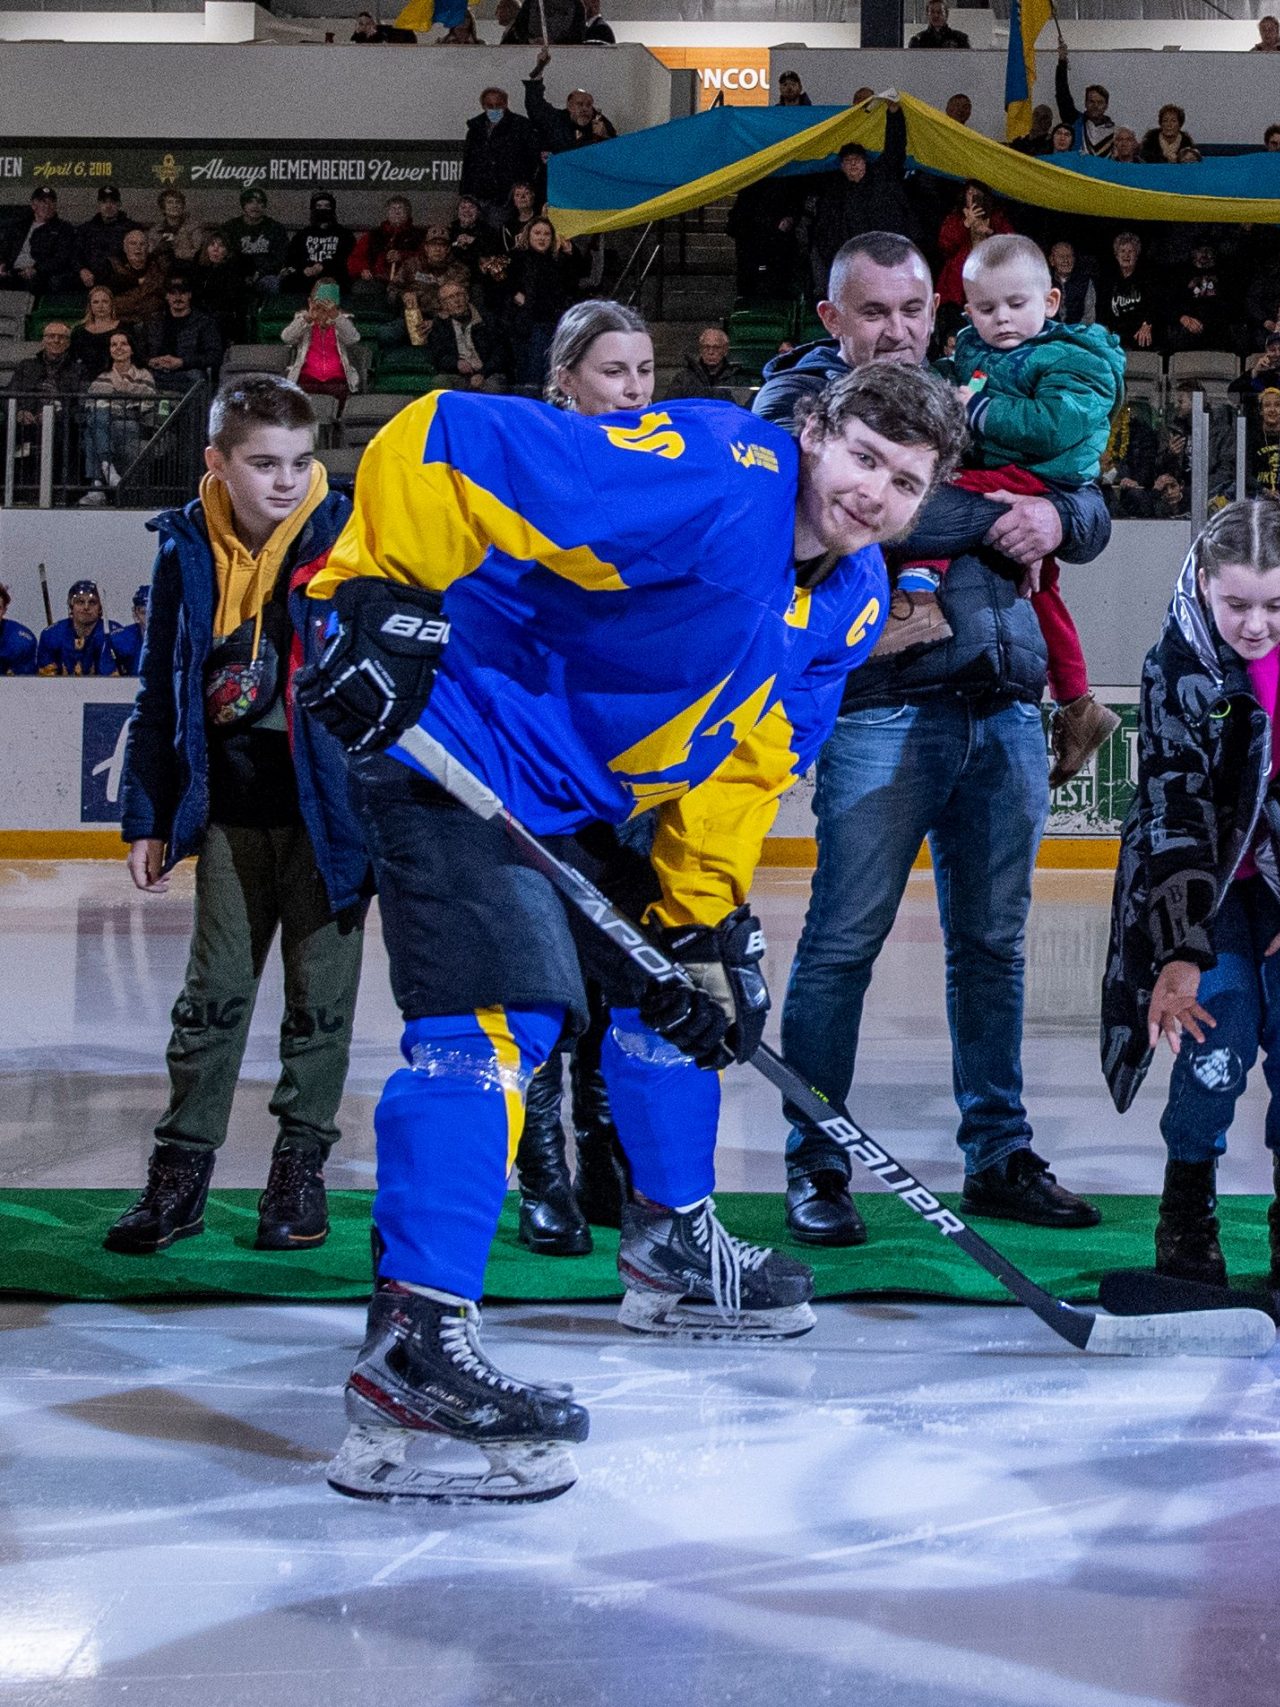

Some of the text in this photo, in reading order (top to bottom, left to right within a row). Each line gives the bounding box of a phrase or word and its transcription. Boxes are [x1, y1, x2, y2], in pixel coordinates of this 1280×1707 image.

[33, 162, 72, 179] April
[89, 162, 112, 176] 2018
[191, 158, 268, 187] Always
[269, 159, 366, 181] REMEMBERED
[367, 160, 430, 181] Never
[845, 597, 880, 648] C
